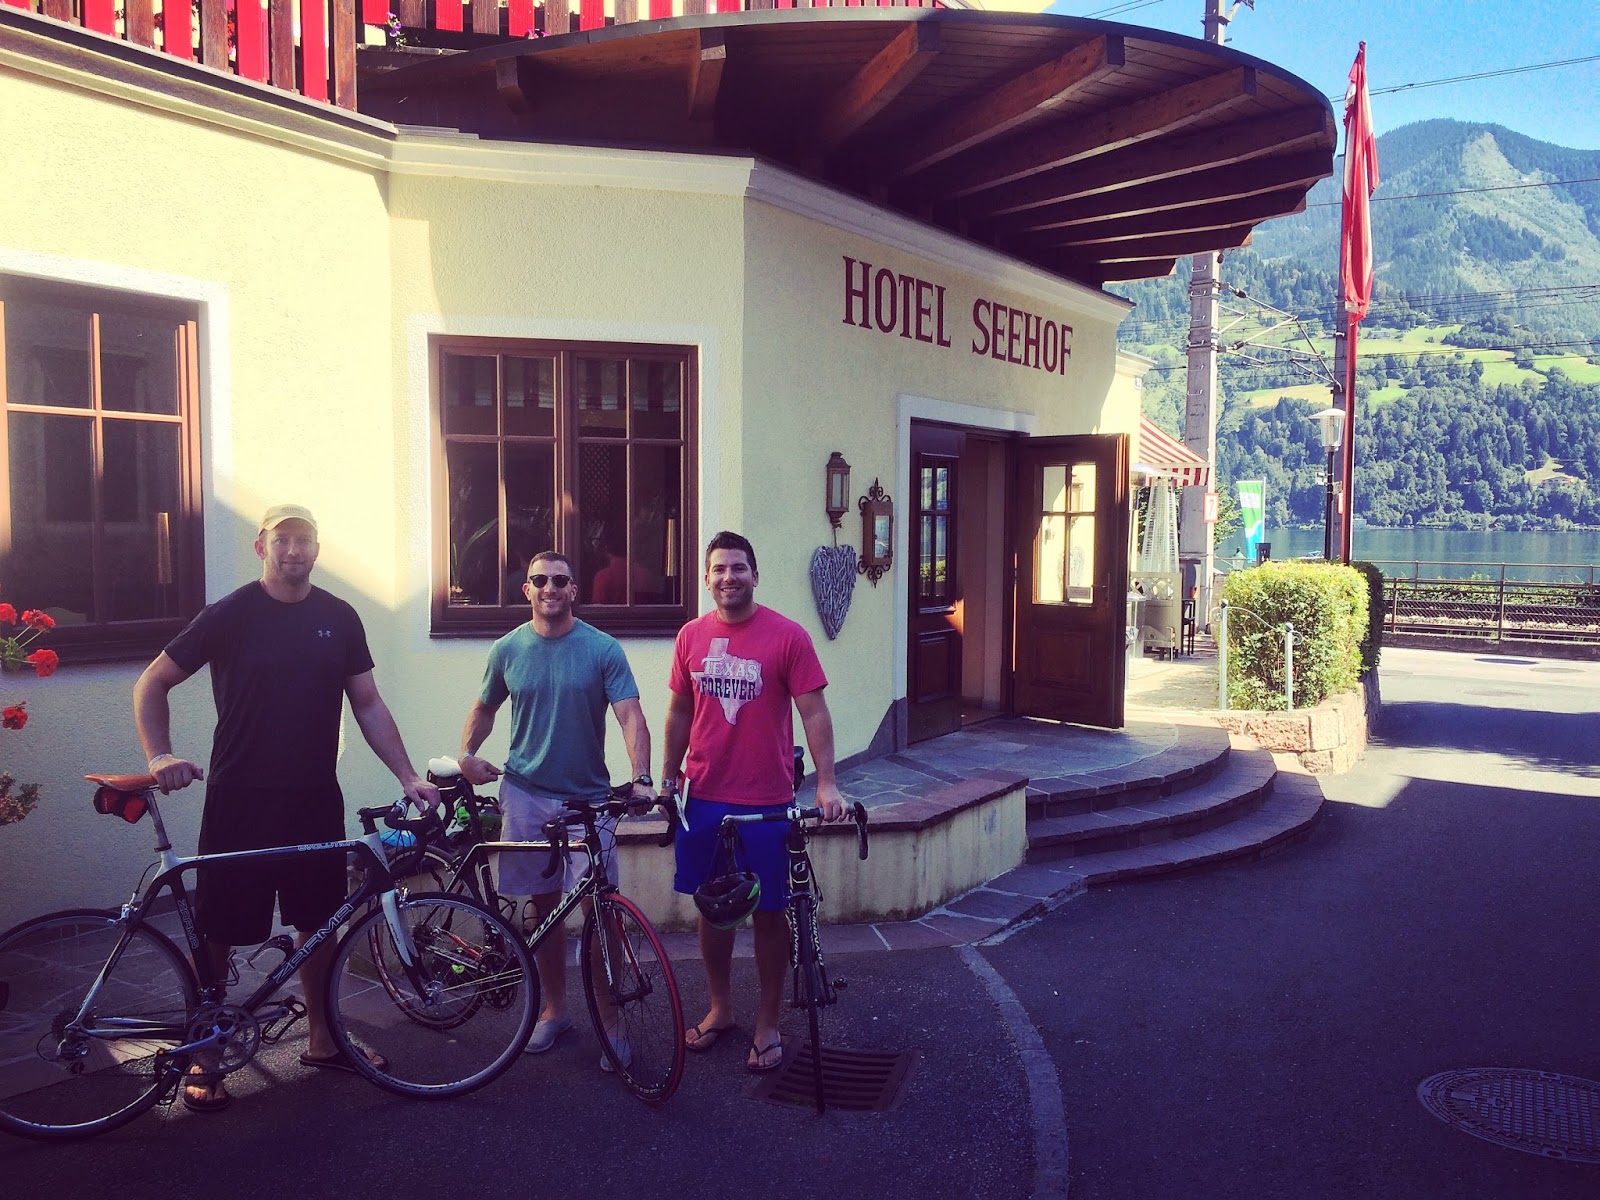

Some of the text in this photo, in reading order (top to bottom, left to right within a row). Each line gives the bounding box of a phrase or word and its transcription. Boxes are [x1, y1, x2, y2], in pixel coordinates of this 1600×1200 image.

[842, 255, 1074, 376] HOTEL SEEHOF
[701, 653, 758, 682] TEXAS
[701, 677, 757, 701] FOREVER
[272, 903, 355, 984] ZARMA
